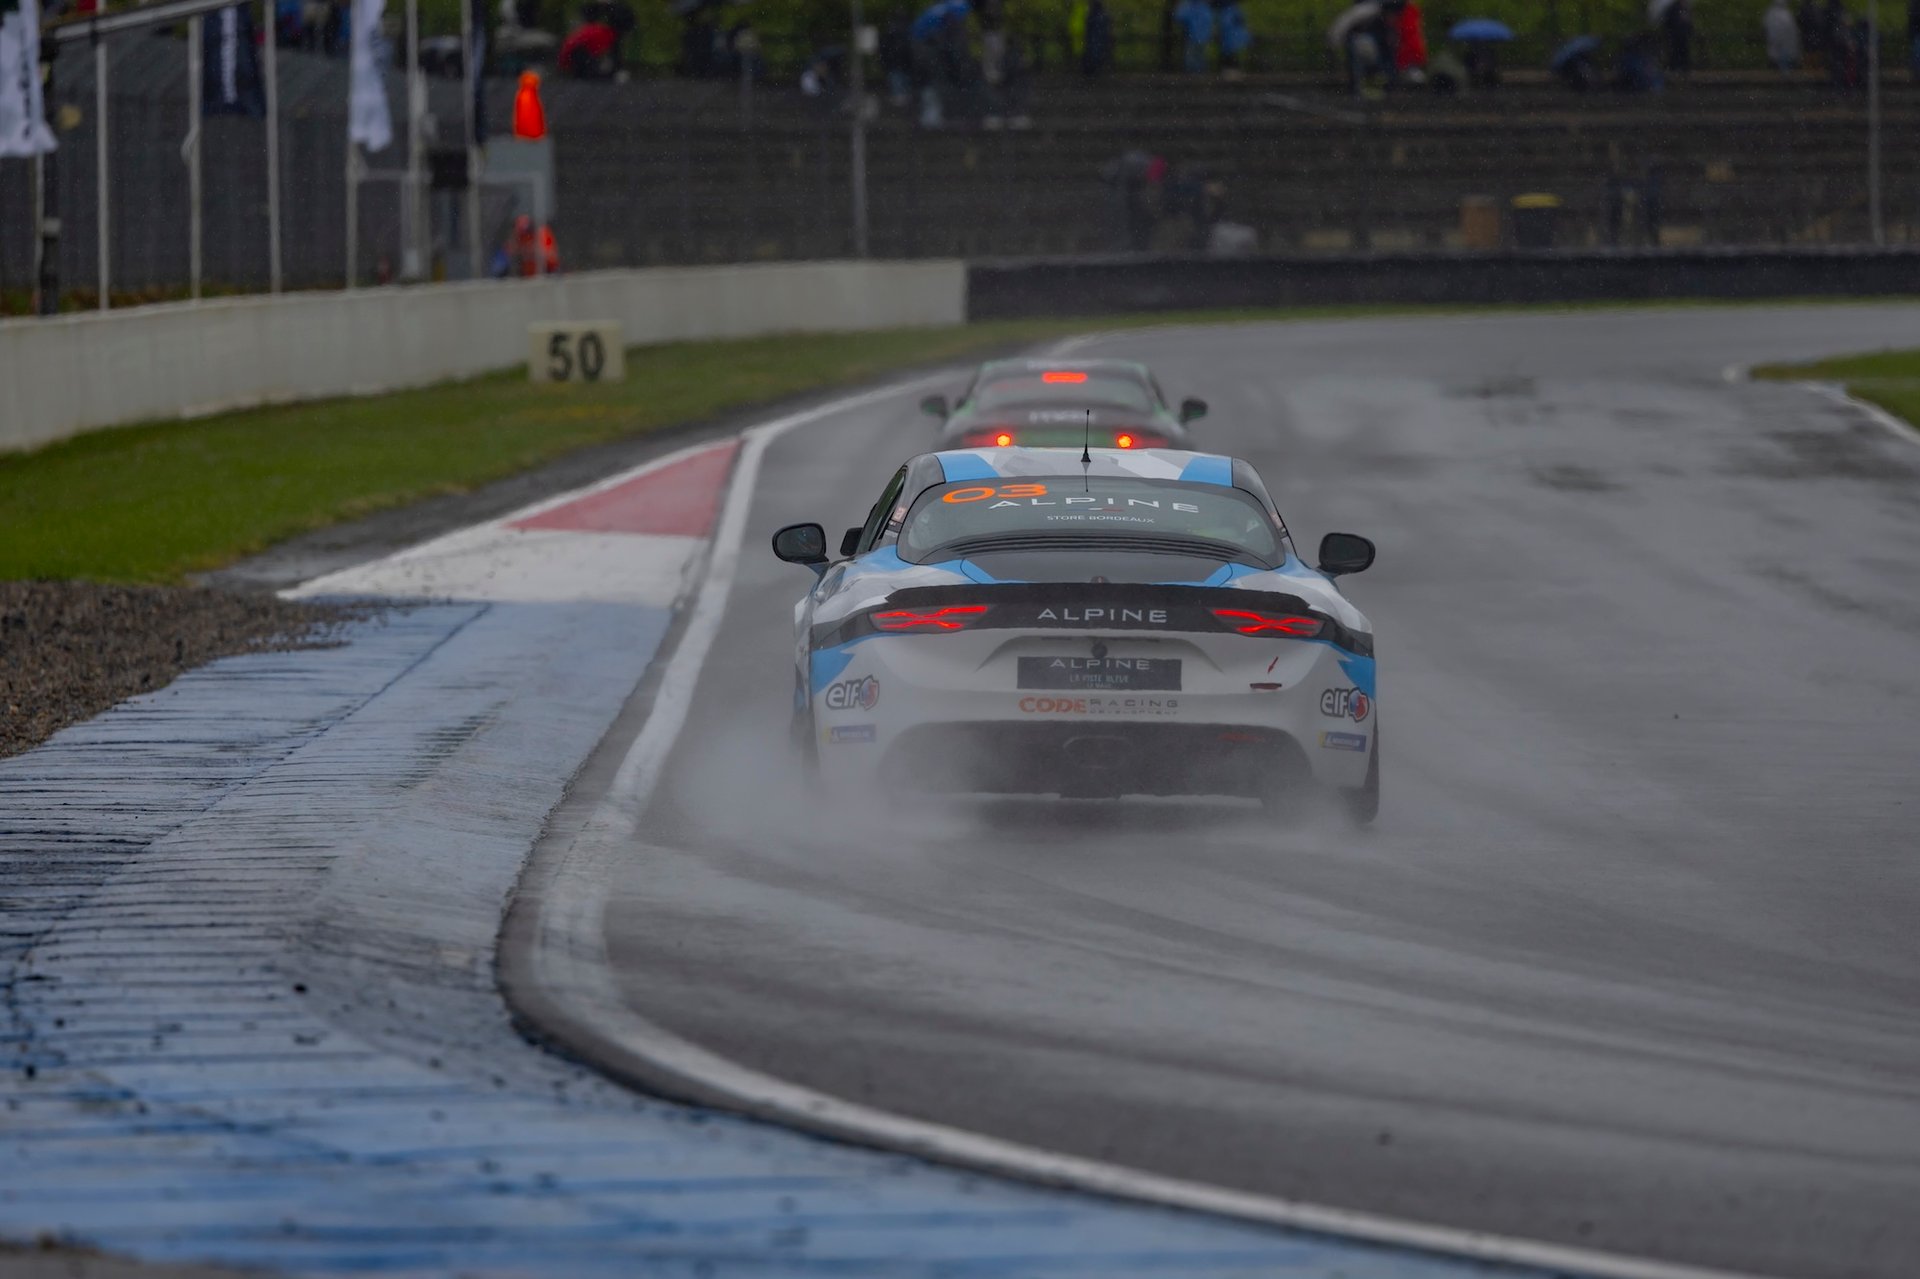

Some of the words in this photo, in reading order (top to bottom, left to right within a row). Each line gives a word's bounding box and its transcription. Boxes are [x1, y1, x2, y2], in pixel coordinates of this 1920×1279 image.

[547, 331, 605, 381] 50
[942, 483, 1048, 503] 03
[988, 497, 1199, 513] ALPINE
[1089, 515, 1156, 523] BORDEAUX
[1037, 608, 1168, 623] ALPINE
[1050, 658, 1151, 670] ALPINE
[826, 679, 860, 710] elf
[1320, 688, 1349, 718] elf
[1018, 696, 1087, 713] CODE
[1090, 699, 1178, 708] RACING
